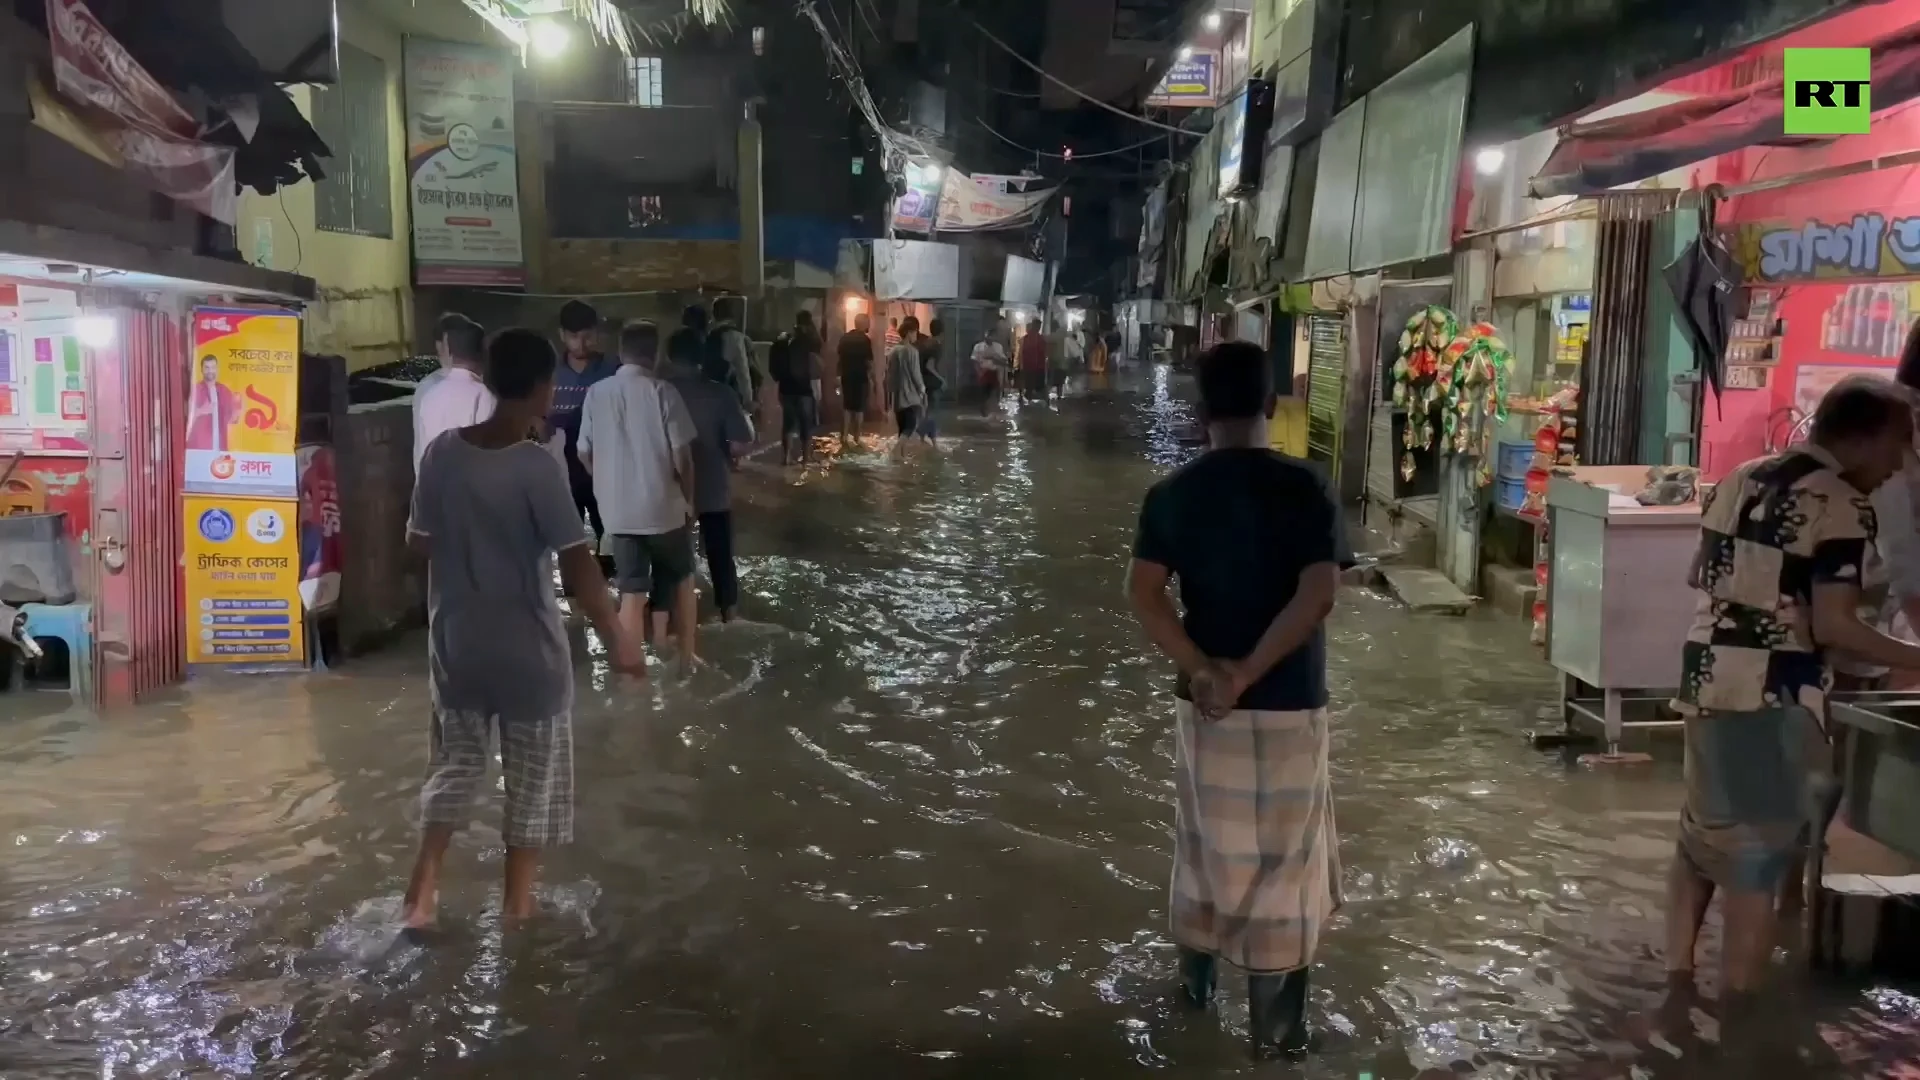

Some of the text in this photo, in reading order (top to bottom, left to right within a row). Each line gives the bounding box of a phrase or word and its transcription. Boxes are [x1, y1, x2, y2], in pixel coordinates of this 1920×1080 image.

[245, 384, 278, 430] ৯
[240, 460, 272, 475] নগদ
[196, 553, 289, 570] ট্রাফিক কেসের
